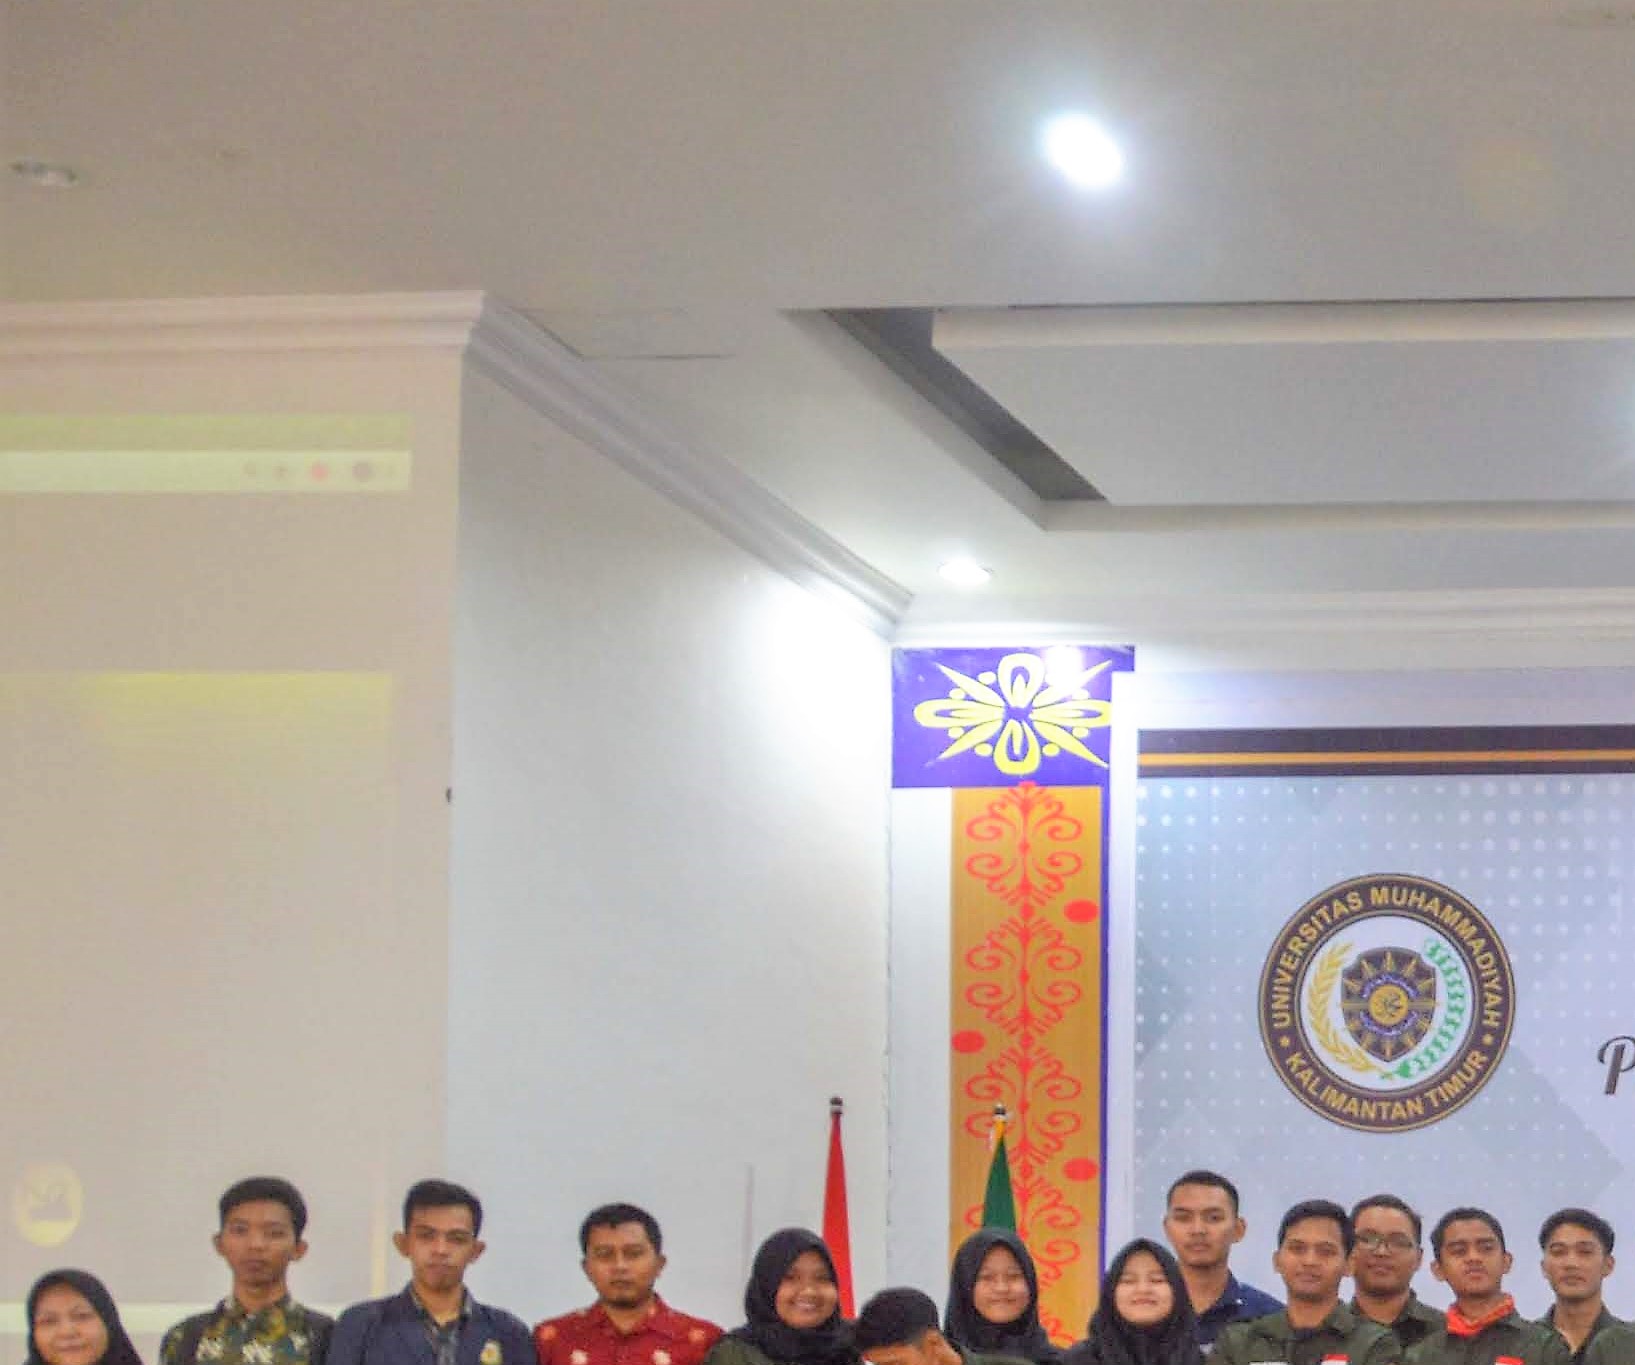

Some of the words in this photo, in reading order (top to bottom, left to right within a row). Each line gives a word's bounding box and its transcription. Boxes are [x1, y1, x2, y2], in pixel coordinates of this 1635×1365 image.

[1271, 890, 1364, 1029] UNIVERSITAS
[1370, 886, 1503, 1029] MUHAMMADIYAH
[1285, 1051, 1426, 1121] KALIMANTAN
[1423, 1050, 1489, 1109] TIMUR
